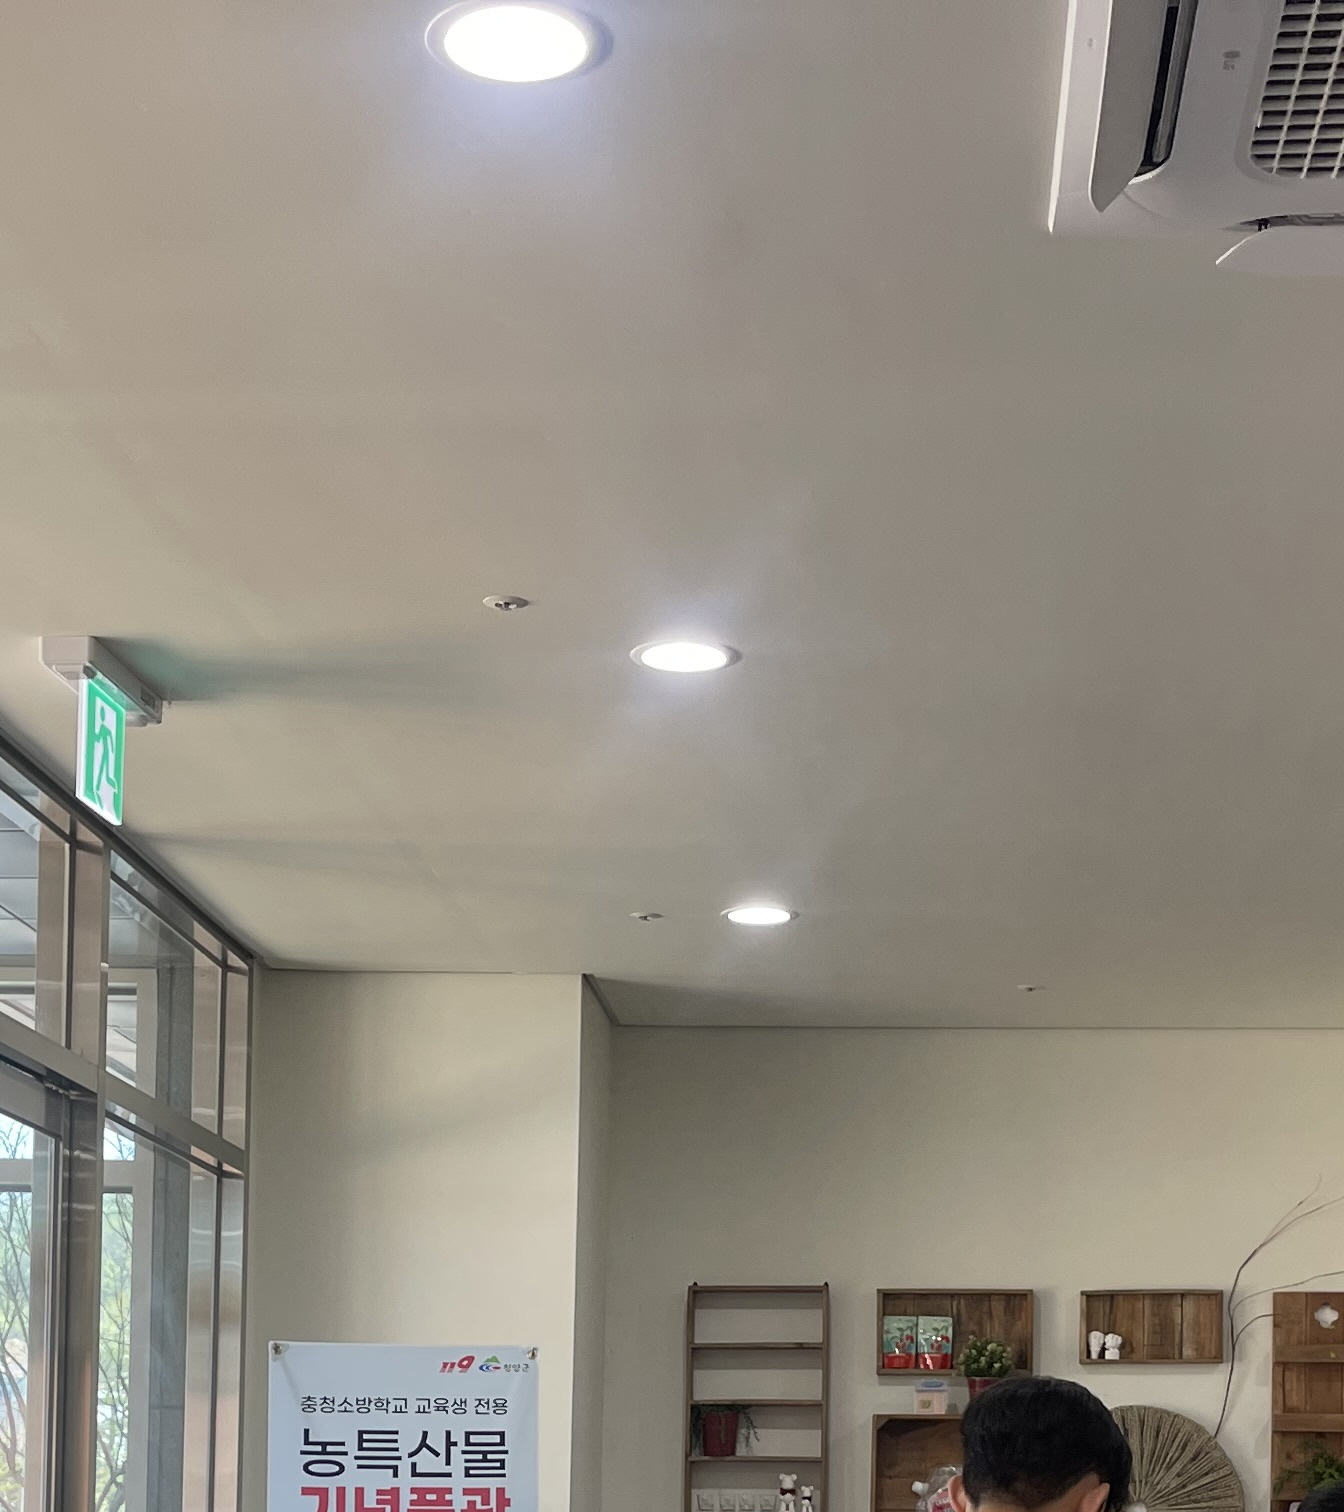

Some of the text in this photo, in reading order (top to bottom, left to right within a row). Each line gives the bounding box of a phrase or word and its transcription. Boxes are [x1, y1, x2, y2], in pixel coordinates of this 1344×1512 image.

[439, 1355, 475, 1373] 119
[300, 1396, 509, 1416] 충청소방학교 교육생 전용
[299, 1427, 510, 1479] 농특산물
